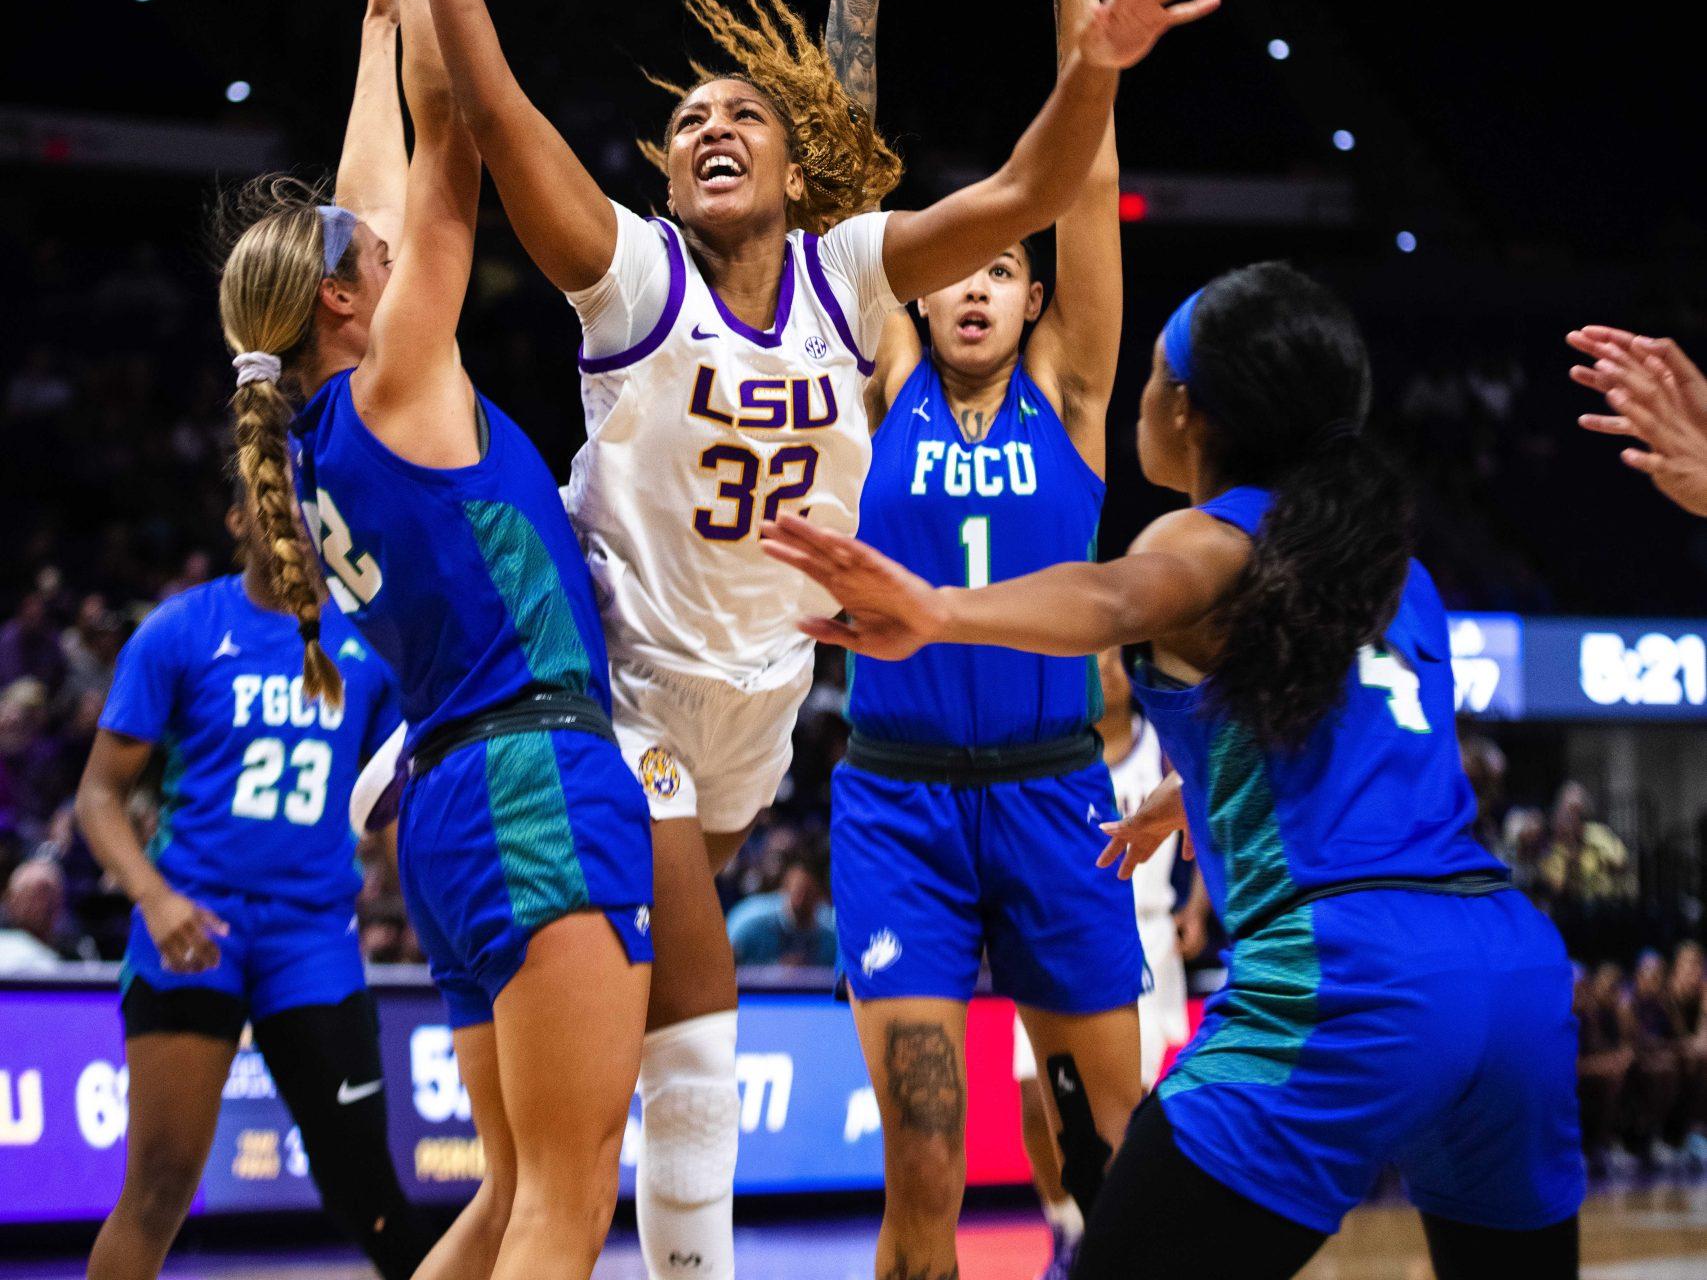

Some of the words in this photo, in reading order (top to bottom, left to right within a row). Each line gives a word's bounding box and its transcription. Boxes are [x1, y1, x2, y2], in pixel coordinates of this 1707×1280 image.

[687, 363, 840, 434] LSU
[691, 440, 820, 544] 32
[910, 438, 1038, 498] FGCU
[231, 736, 333, 827] 23
